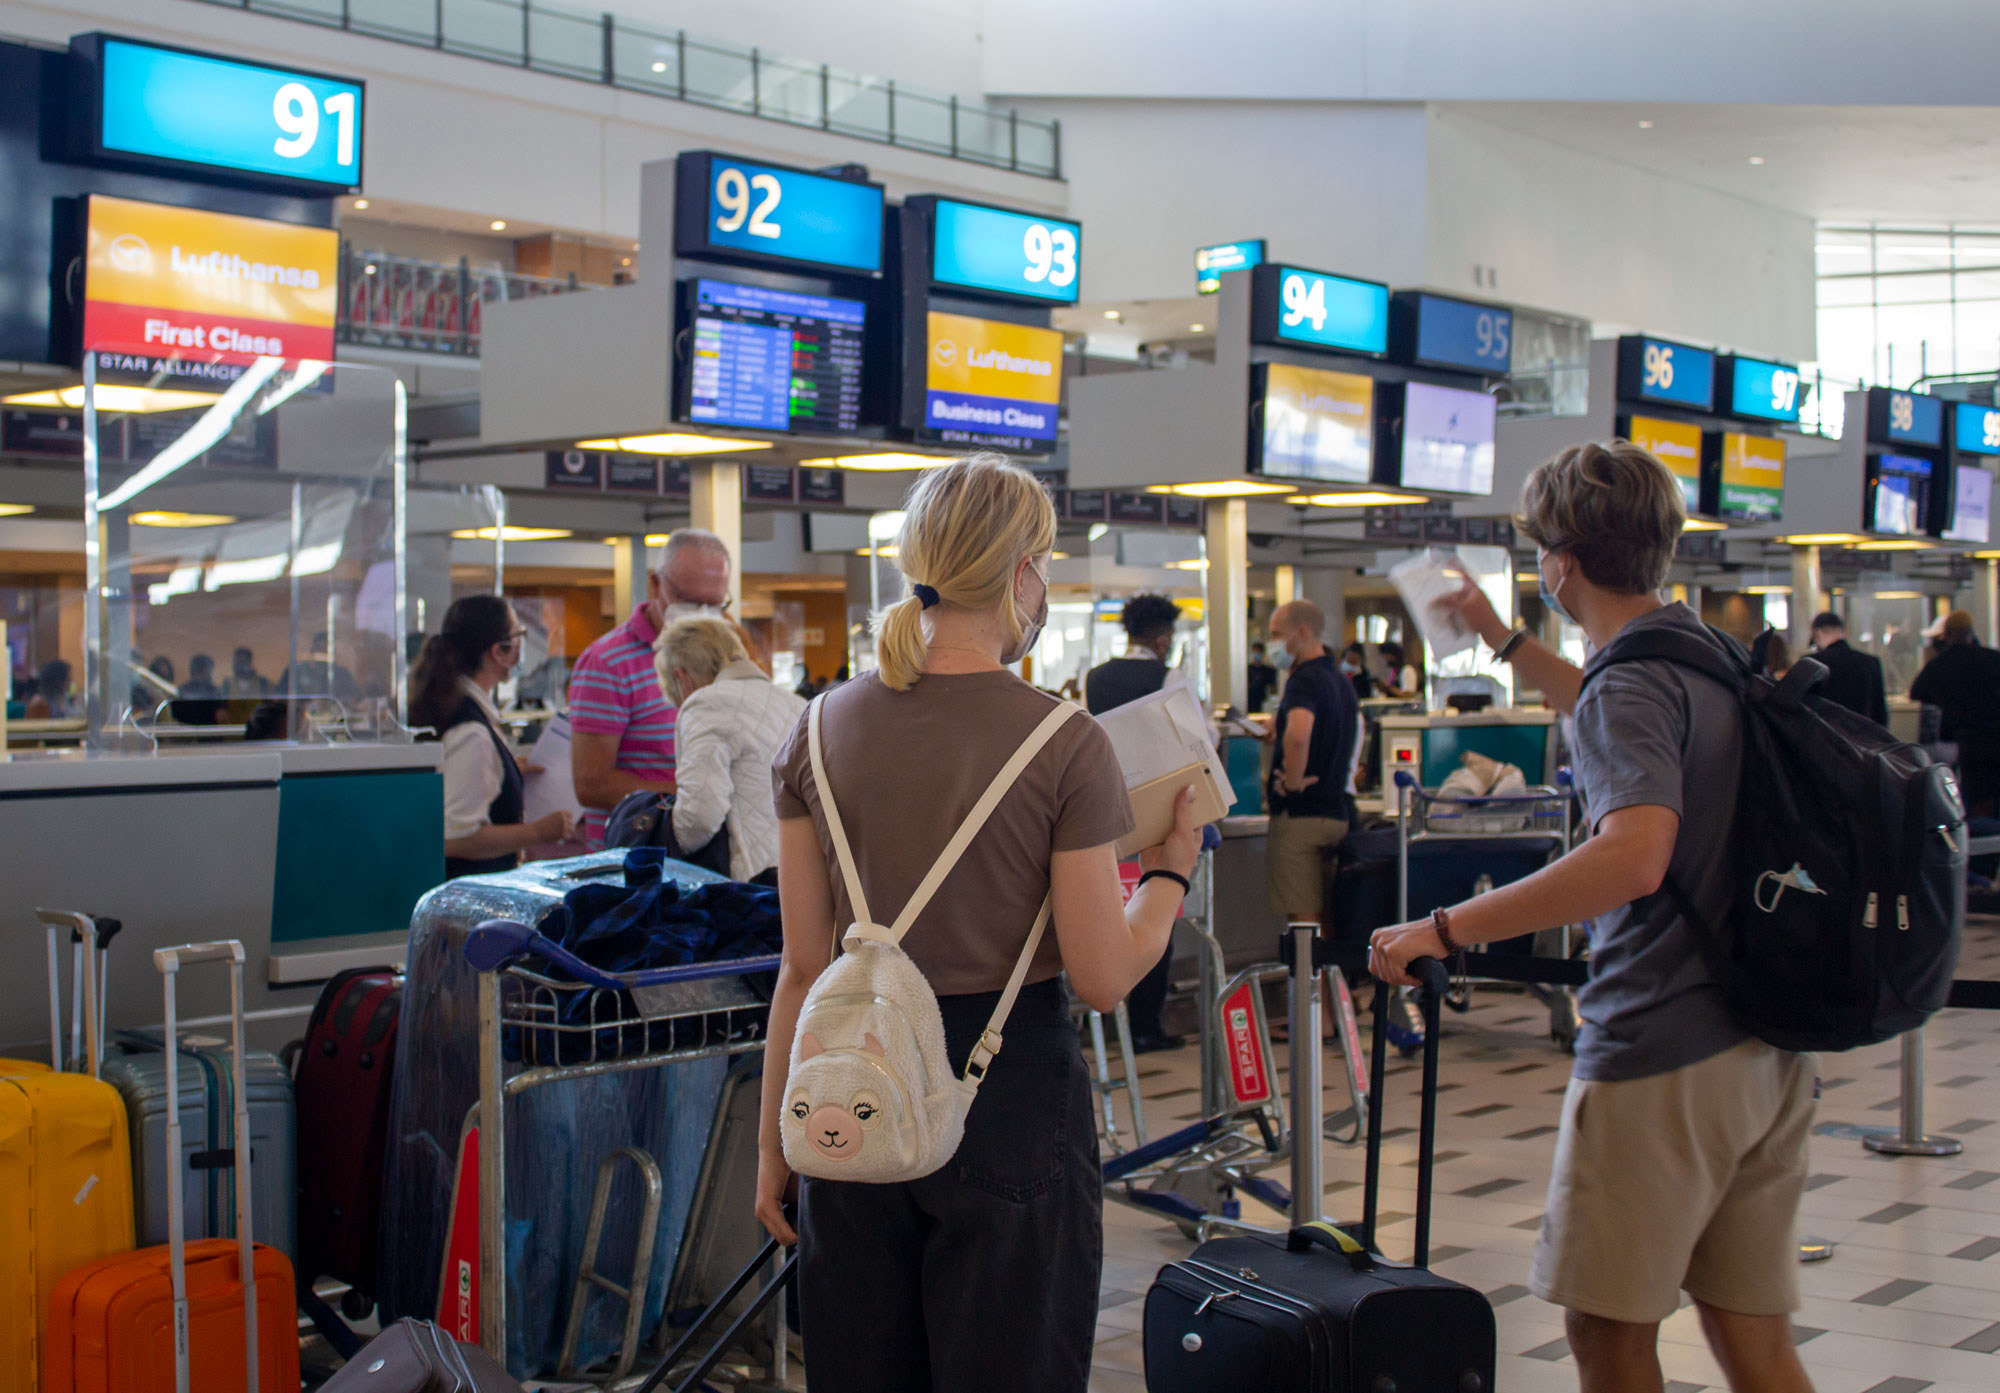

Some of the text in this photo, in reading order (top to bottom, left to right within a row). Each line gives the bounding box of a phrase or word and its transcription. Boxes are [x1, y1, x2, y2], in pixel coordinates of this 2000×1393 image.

[273, 82, 354, 166] 91
[715, 167, 782, 239] 92
[171, 246, 319, 289] Lufthansa
[1023, 224, 1076, 286] 93
[1283, 275, 1327, 331] 94
[144, 319, 283, 356] First Class
[1476, 312, 1509, 359] 95
[100, 354, 242, 380] STAR ALLIANCE
[968, 347, 1051, 376] Lufthansa
[1644, 344, 1673, 389] 96
[1301, 393, 1363, 416] Lufthansa
[1771, 369, 1798, 412] 97
[932, 399, 1046, 430] Business Class
[1891, 394, 1912, 431] 98
[942, 430, 1021, 449] STAR ALLIANCE
[1237, 1028, 1256, 1078] SPAR
[460, 1296, 470, 1342] AR
